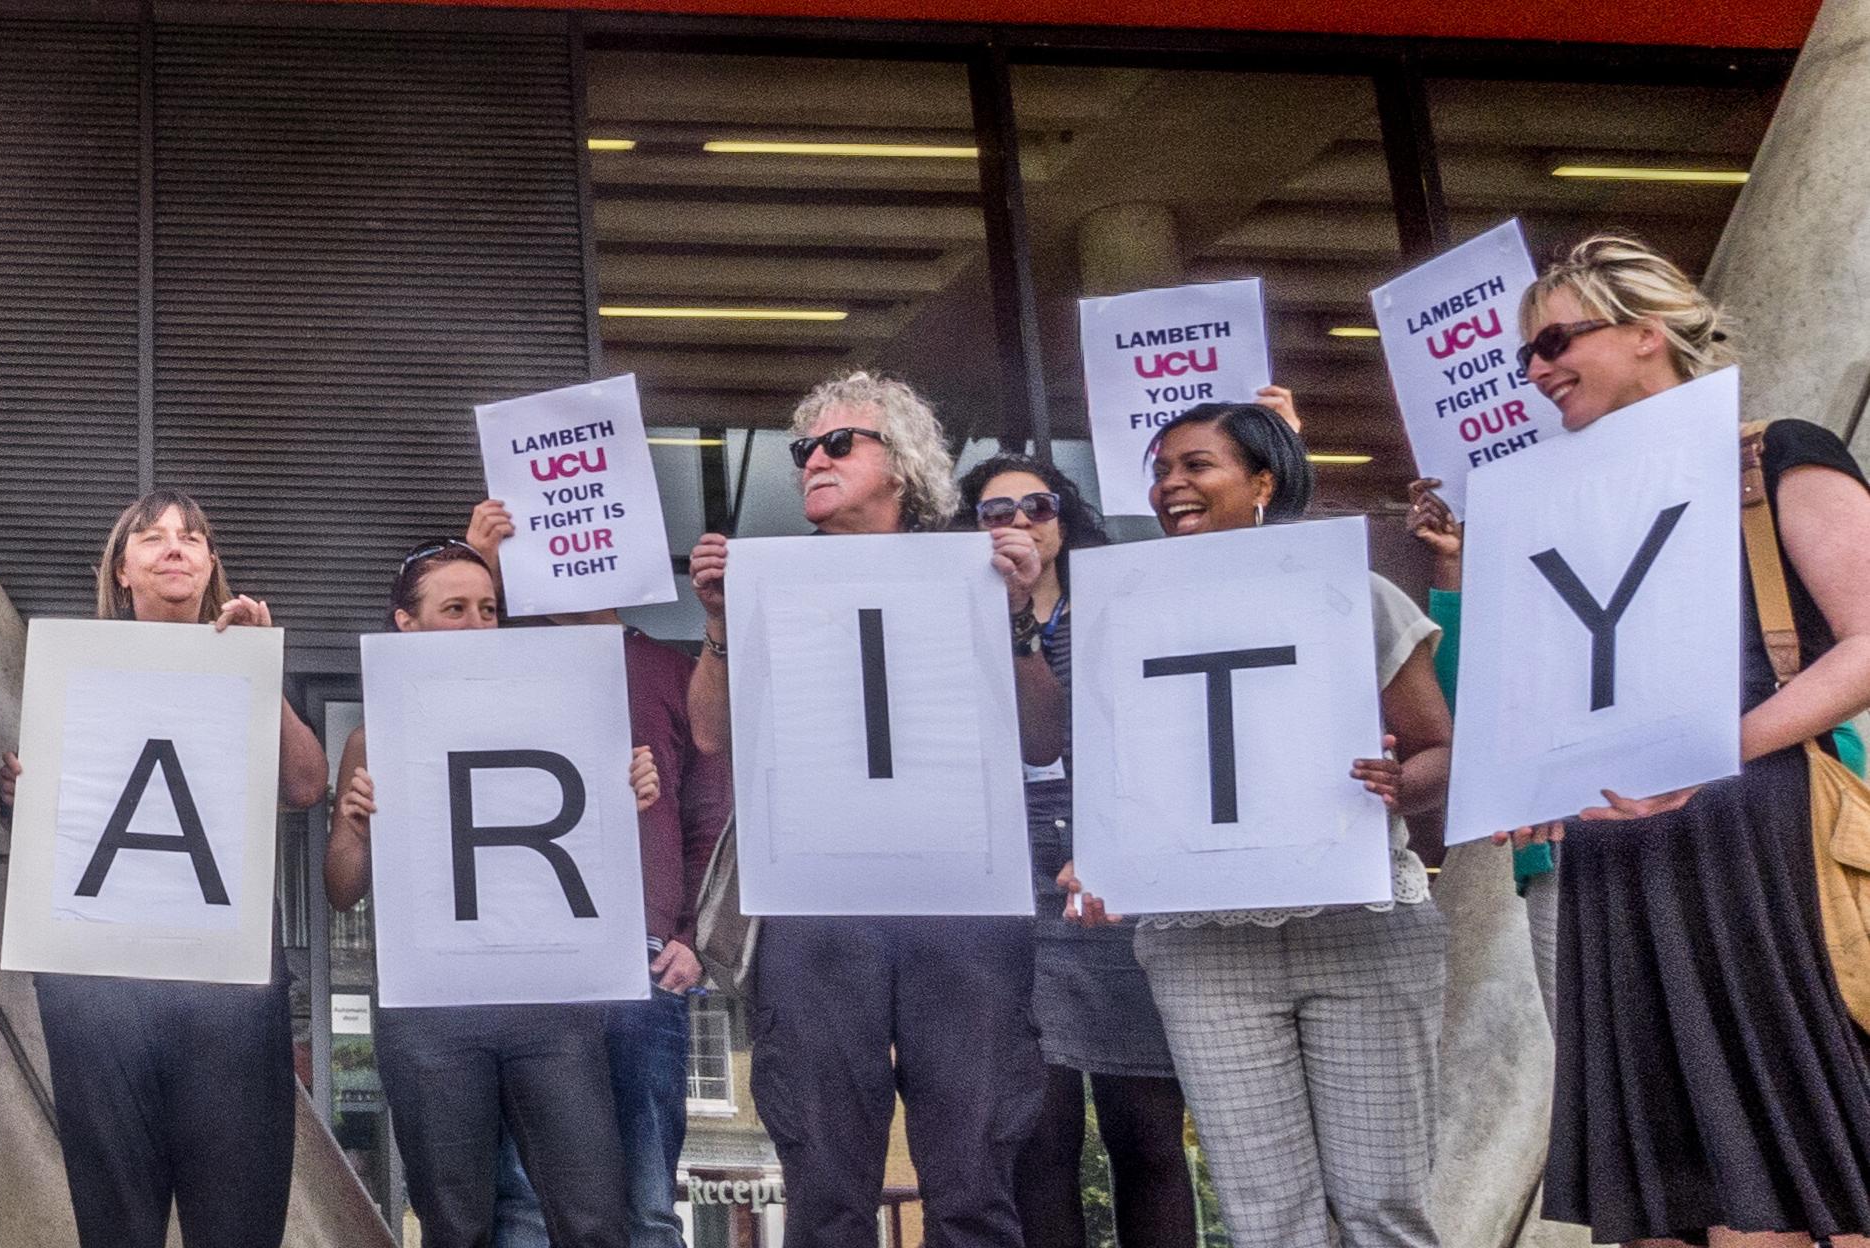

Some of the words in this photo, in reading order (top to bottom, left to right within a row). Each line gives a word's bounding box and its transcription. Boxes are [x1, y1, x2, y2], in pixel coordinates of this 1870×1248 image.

[1407, 276, 1505, 335] LAMBETH
[1116, 321, 1230, 349] LAMBETH
[1443, 348, 1505, 385] YOUR
[1146, 383, 1213, 404] YOUR
[1435, 378, 1499, 418] FIGHT
[1508, 367, 1530, 389] IS
[512, 420, 615, 454] LAMBETH
[1130, 409, 1185, 430] FIG
[1460, 400, 1530, 442] OUR
[1468, 429, 1539, 468] FIGHT
[543, 483, 604, 505] YOUR
[530, 507, 594, 531] FIGHT
[604, 503, 625, 519] IS
[549, 528, 613, 556] OUR
[553, 555, 618, 577] FIGHT
[1529, 502, 1690, 712] Y
[858, 609, 893, 779] I
[1143, 645, 1296, 824] T
[74, 739, 231, 905] A
[448, 750, 599, 921] R
